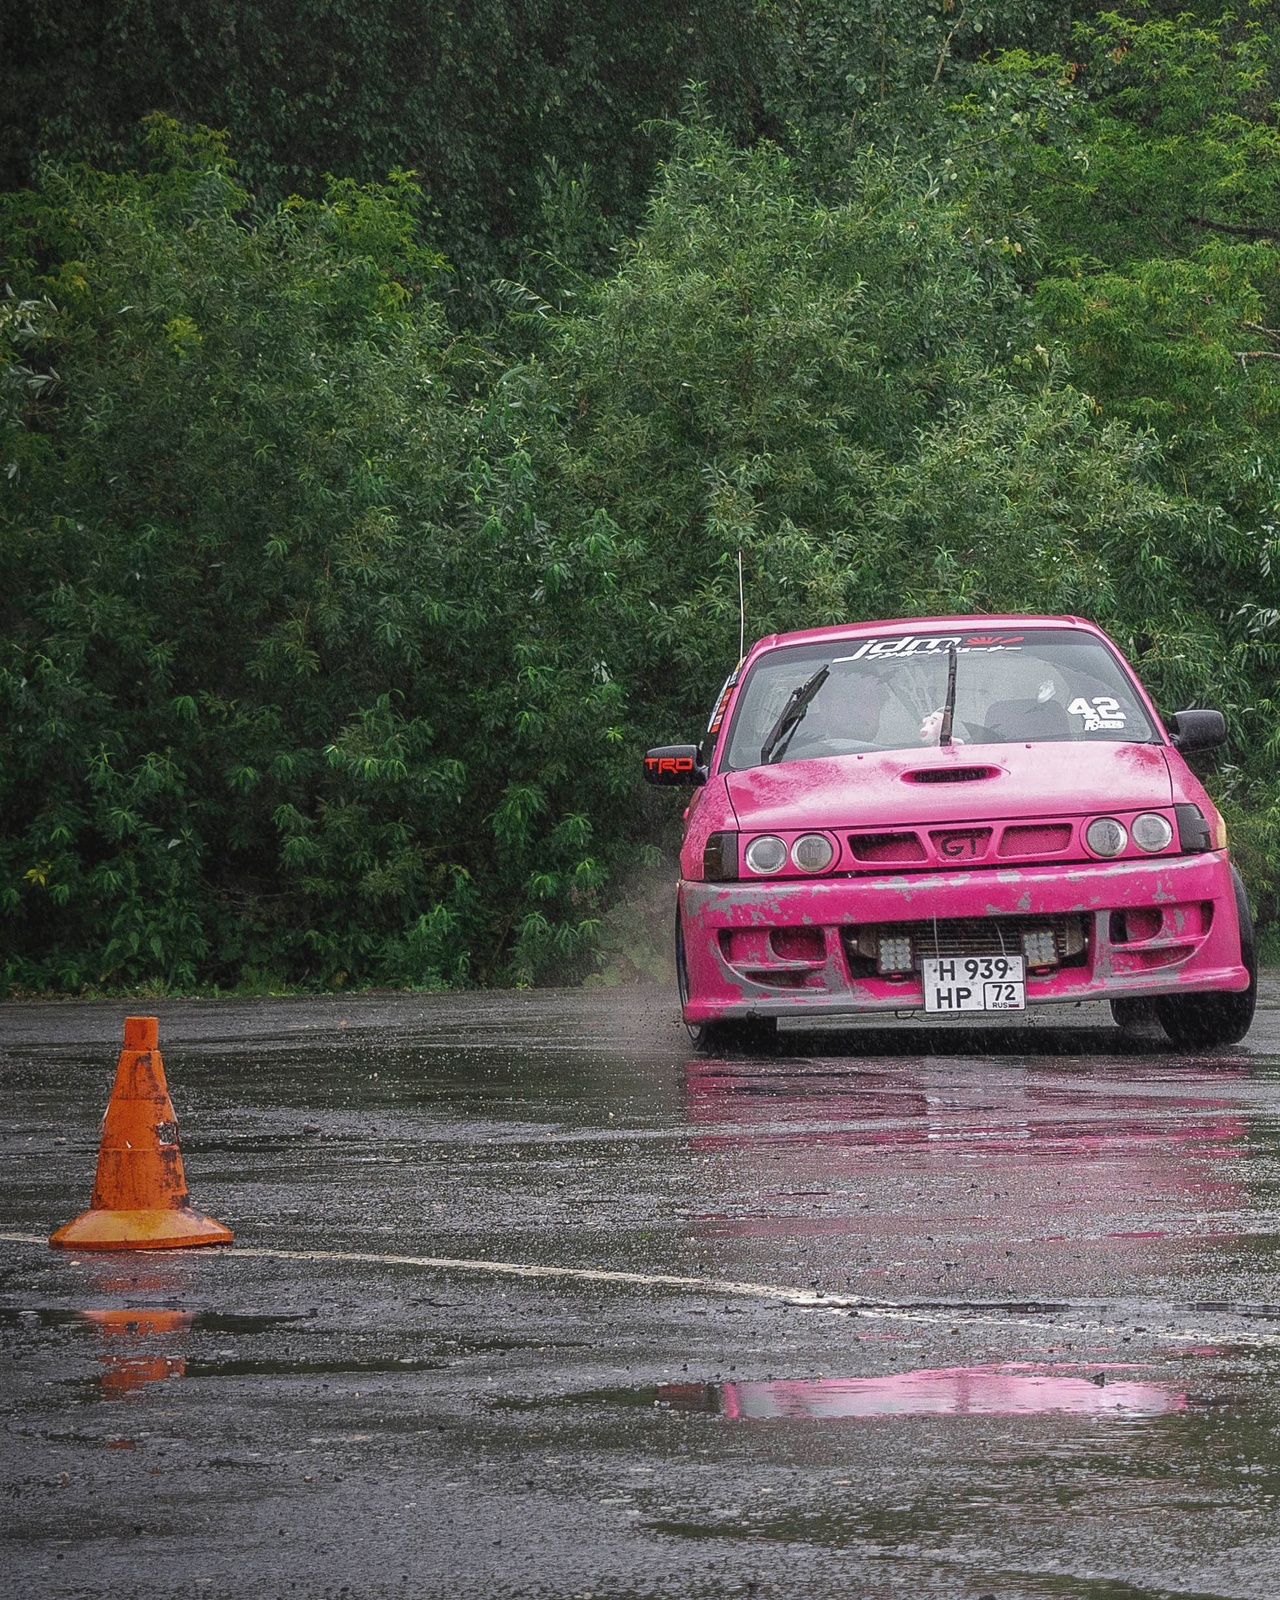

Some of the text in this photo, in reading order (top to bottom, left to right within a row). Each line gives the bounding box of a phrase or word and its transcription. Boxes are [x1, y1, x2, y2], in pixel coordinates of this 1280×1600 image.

[832, 636, 962, 663] jdm
[1067, 697, 1127, 719] 42
[645, 758, 692, 773] TRD
[941, 834, 985, 856] GT
[965, 959, 1008, 980] 939
[992, 985, 1016, 1001] 72
